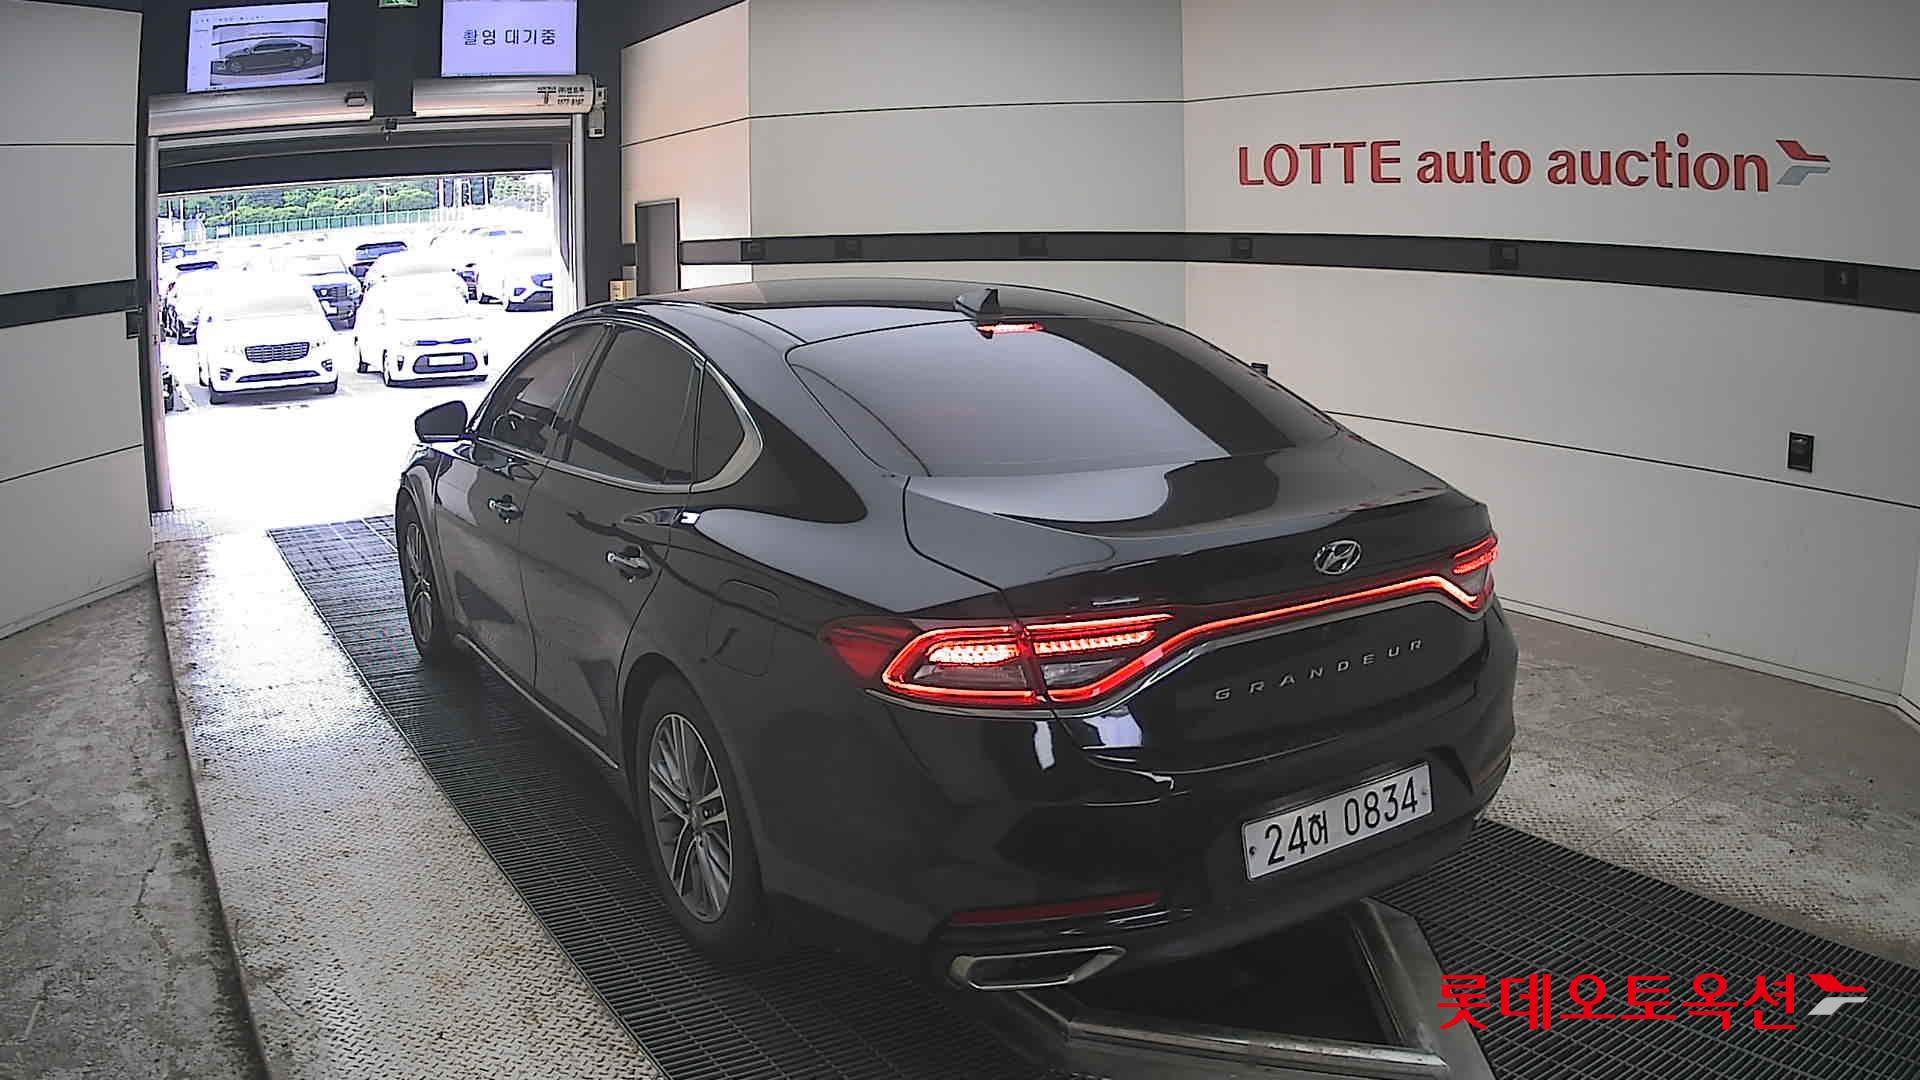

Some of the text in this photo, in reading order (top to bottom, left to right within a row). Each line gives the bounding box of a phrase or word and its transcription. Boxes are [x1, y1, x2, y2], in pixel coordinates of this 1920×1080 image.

[504, 29, 556, 46] 대기중
[1239, 132, 1769, 192] LOTTE auto auction
[1214, 638, 1423, 701] GRANDEUR
[1264, 776, 1419, 867] 24허 0834
